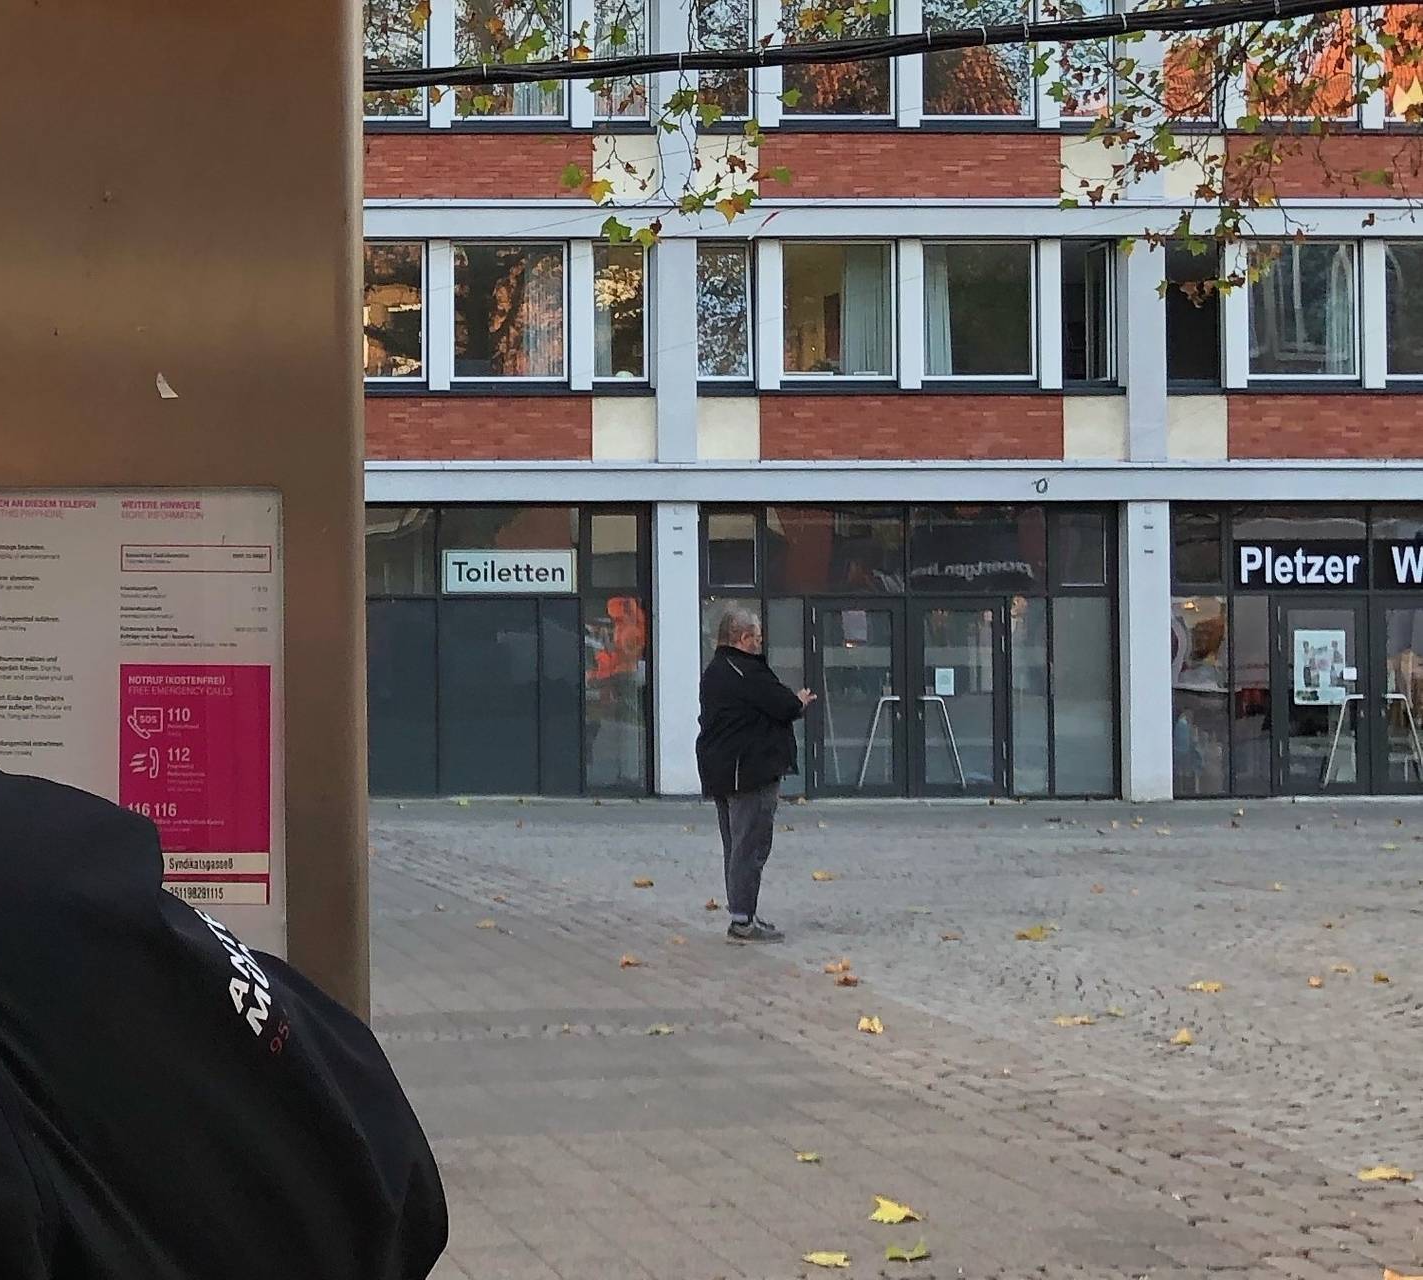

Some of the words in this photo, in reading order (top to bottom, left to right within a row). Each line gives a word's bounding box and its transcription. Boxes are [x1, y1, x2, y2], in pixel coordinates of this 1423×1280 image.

[452, 560, 566, 583] Toiletten
[1240, 546, 1360, 584] Pletzer
[128, 676, 165, 685] NOTRUF
[139, 715, 158, 724] SOS
[167, 707, 191, 722] 110
[167, 747, 191, 762] 112
[153, 802, 178, 817] 116
